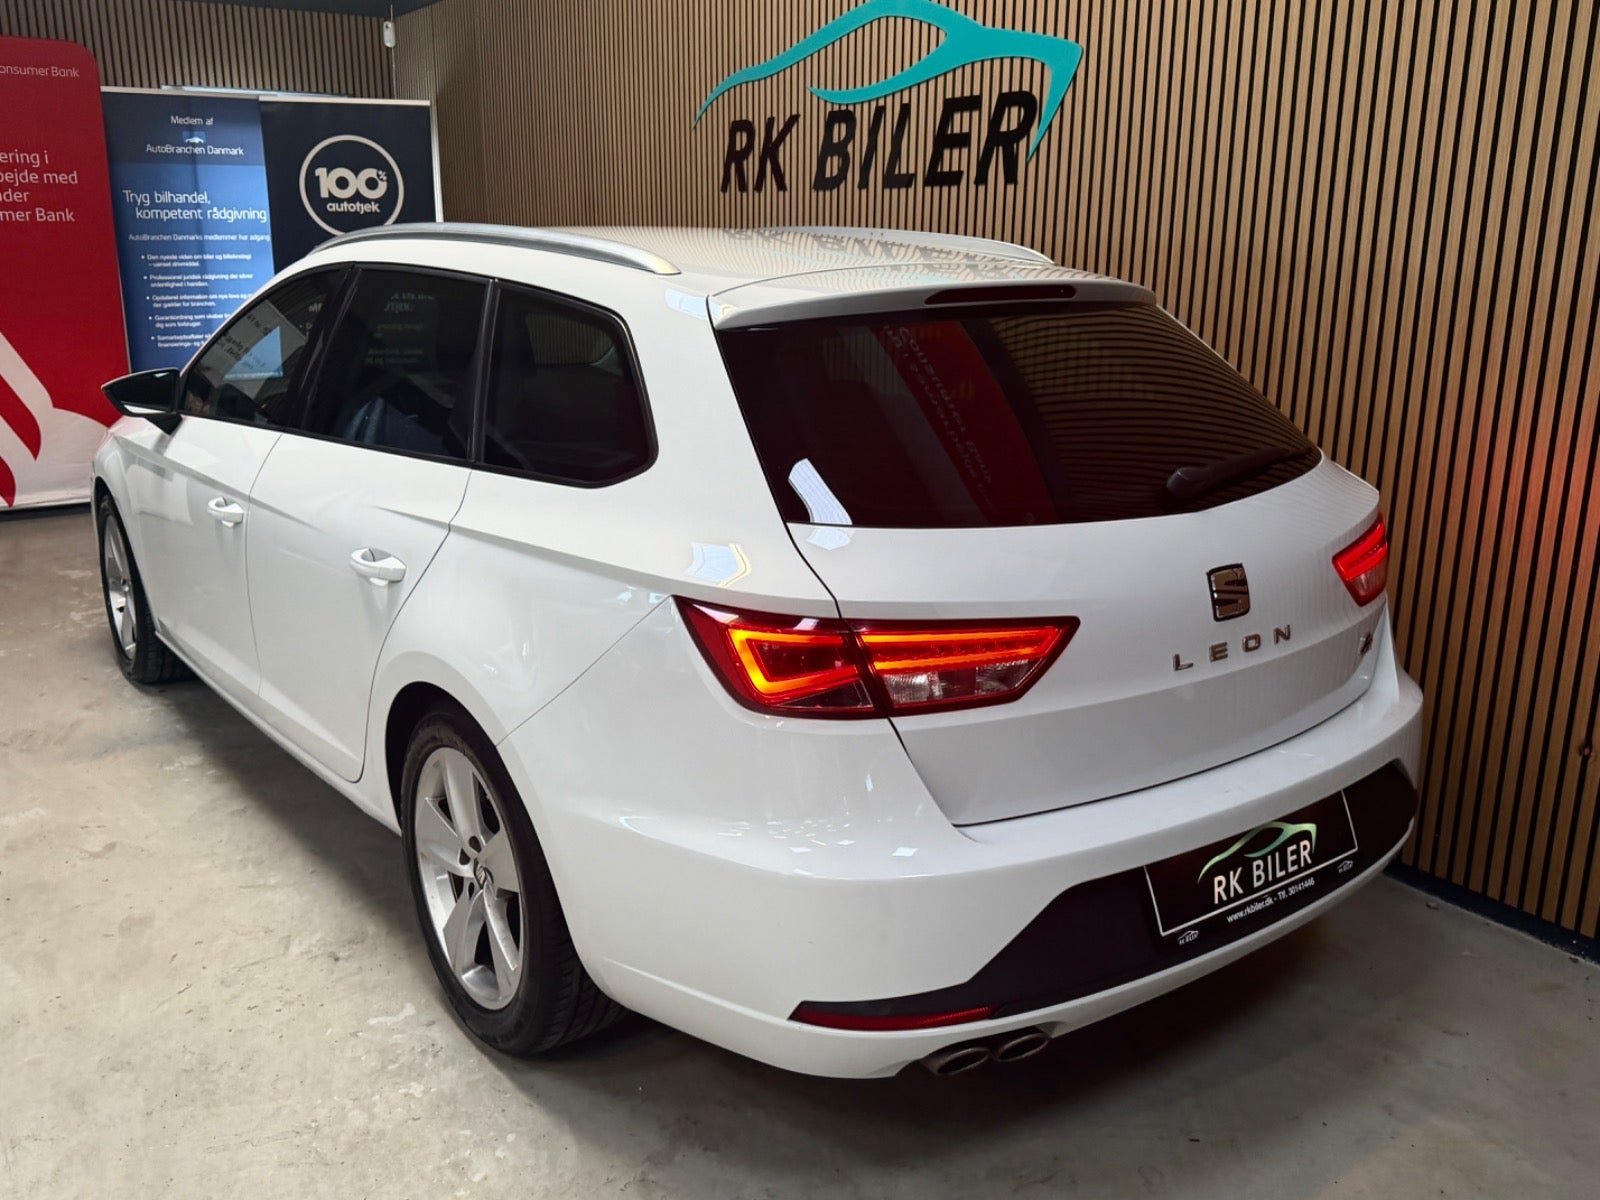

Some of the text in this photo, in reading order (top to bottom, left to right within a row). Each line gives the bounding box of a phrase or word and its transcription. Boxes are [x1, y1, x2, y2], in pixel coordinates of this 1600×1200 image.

[51, 66, 80, 77] Bank
[170, 115, 214, 126] Medlem af
[720, 90, 1038, 193] RK BILER
[145, 143, 244, 156] AutoBranchen Danmark
[44, 150, 49, 164] i
[43, 171, 78, 184] med
[0, 188, 30, 202] der
[122, 190, 211, 206] Tryg bilhandel,
[35, 207, 75, 222] Bank
[135, 206, 267, 223] kompetent rådgivning
[326, 201, 381, 214] autotjek
[128, 233, 173, 241] AutoBranchen
[1173, 624, 1291, 672] LEON
[1213, 839, 1313, 905] RK BILER
[1226, 896, 1275, 924] www.rkbiler.dk
